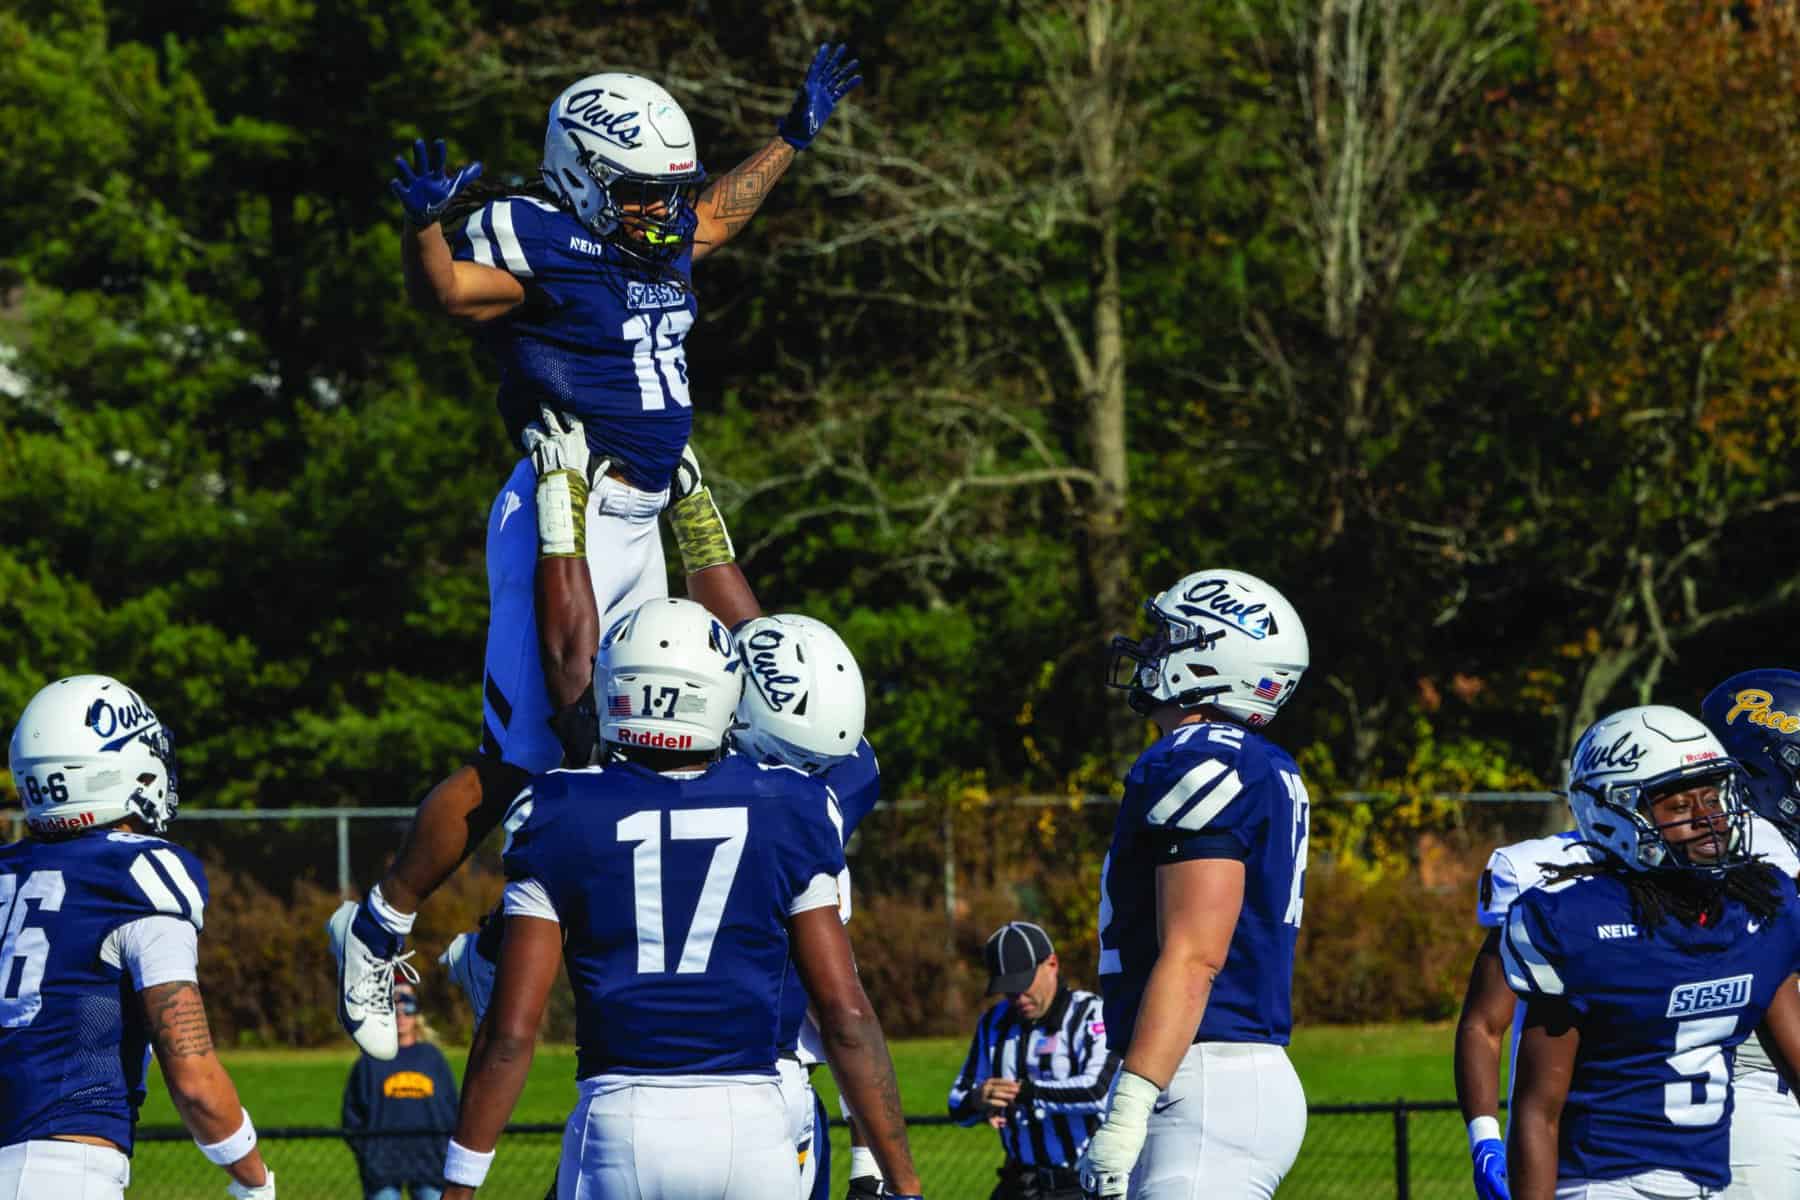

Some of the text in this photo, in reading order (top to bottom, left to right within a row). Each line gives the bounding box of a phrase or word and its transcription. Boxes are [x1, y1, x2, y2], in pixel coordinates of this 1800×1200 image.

[566, 88, 642, 149] Owls
[748, 629, 796, 708] Owls
[617, 728, 692, 749] Riddell
[1173, 724, 1245, 749] 72
[1726, 688, 1800, 734] Pace
[616, 806, 749, 975] 17
[0, 869, 67, 1028] 6
[1671, 978, 1750, 1014] SCSU
[1663, 1015, 1739, 1126] 5
